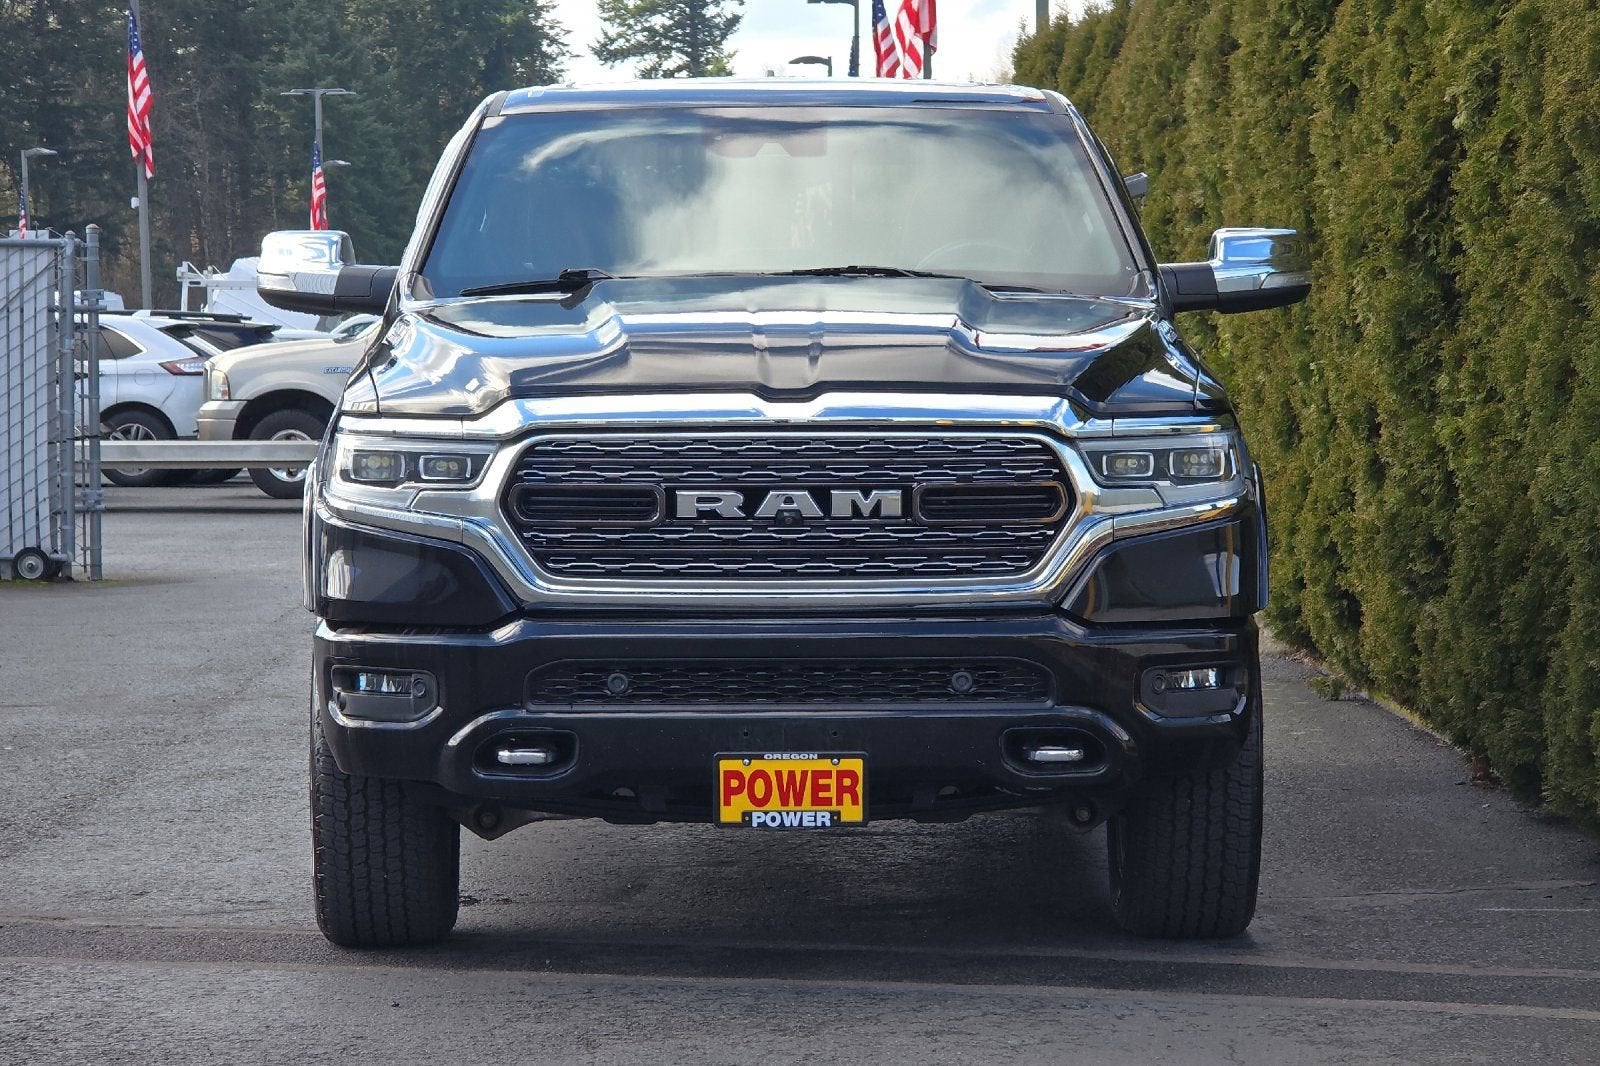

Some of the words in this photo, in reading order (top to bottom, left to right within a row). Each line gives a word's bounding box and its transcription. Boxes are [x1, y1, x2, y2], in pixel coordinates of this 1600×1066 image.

[676, 490, 902, 518] RAM
[723, 769, 860, 808] POWER
[751, 811, 831, 827] POWER
